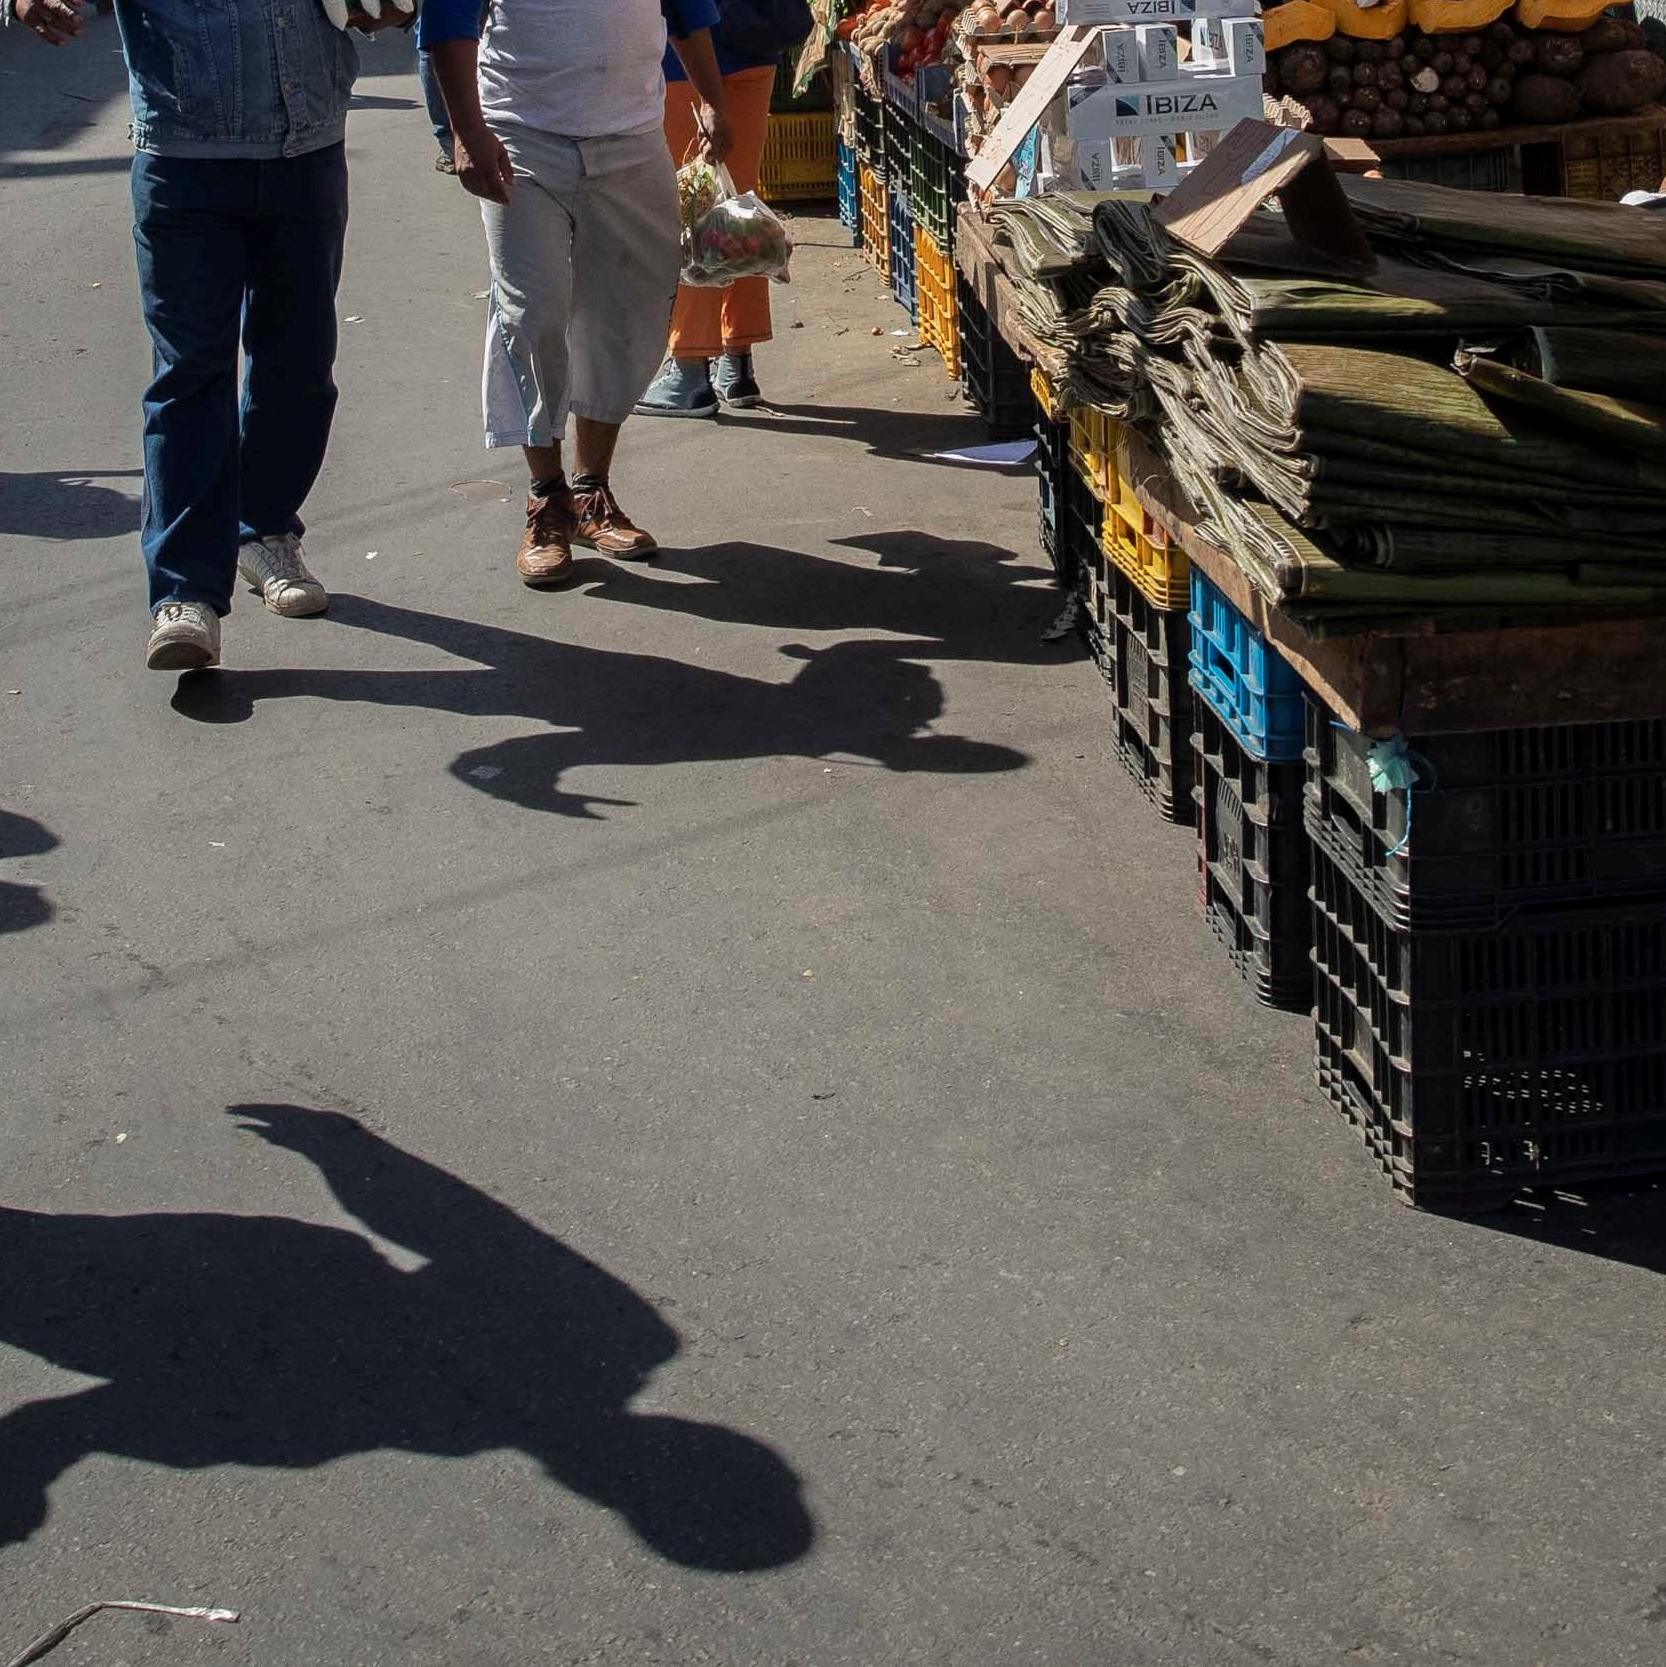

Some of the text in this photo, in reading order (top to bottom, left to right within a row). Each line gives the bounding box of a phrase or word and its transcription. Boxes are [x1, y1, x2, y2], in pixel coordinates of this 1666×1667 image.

[1127, 0, 1176, 15] IBIZA
[1117, 42, 1126, 73] IBIZA
[1158, 40, 1166, 70] IBIZA
[1245, 34, 1253, 63] IBIZA
[1146, 93, 1218, 116] IBIZA
[1091, 152, 1101, 182] IBIZA
[1157, 146, 1165, 176] IBIZA
